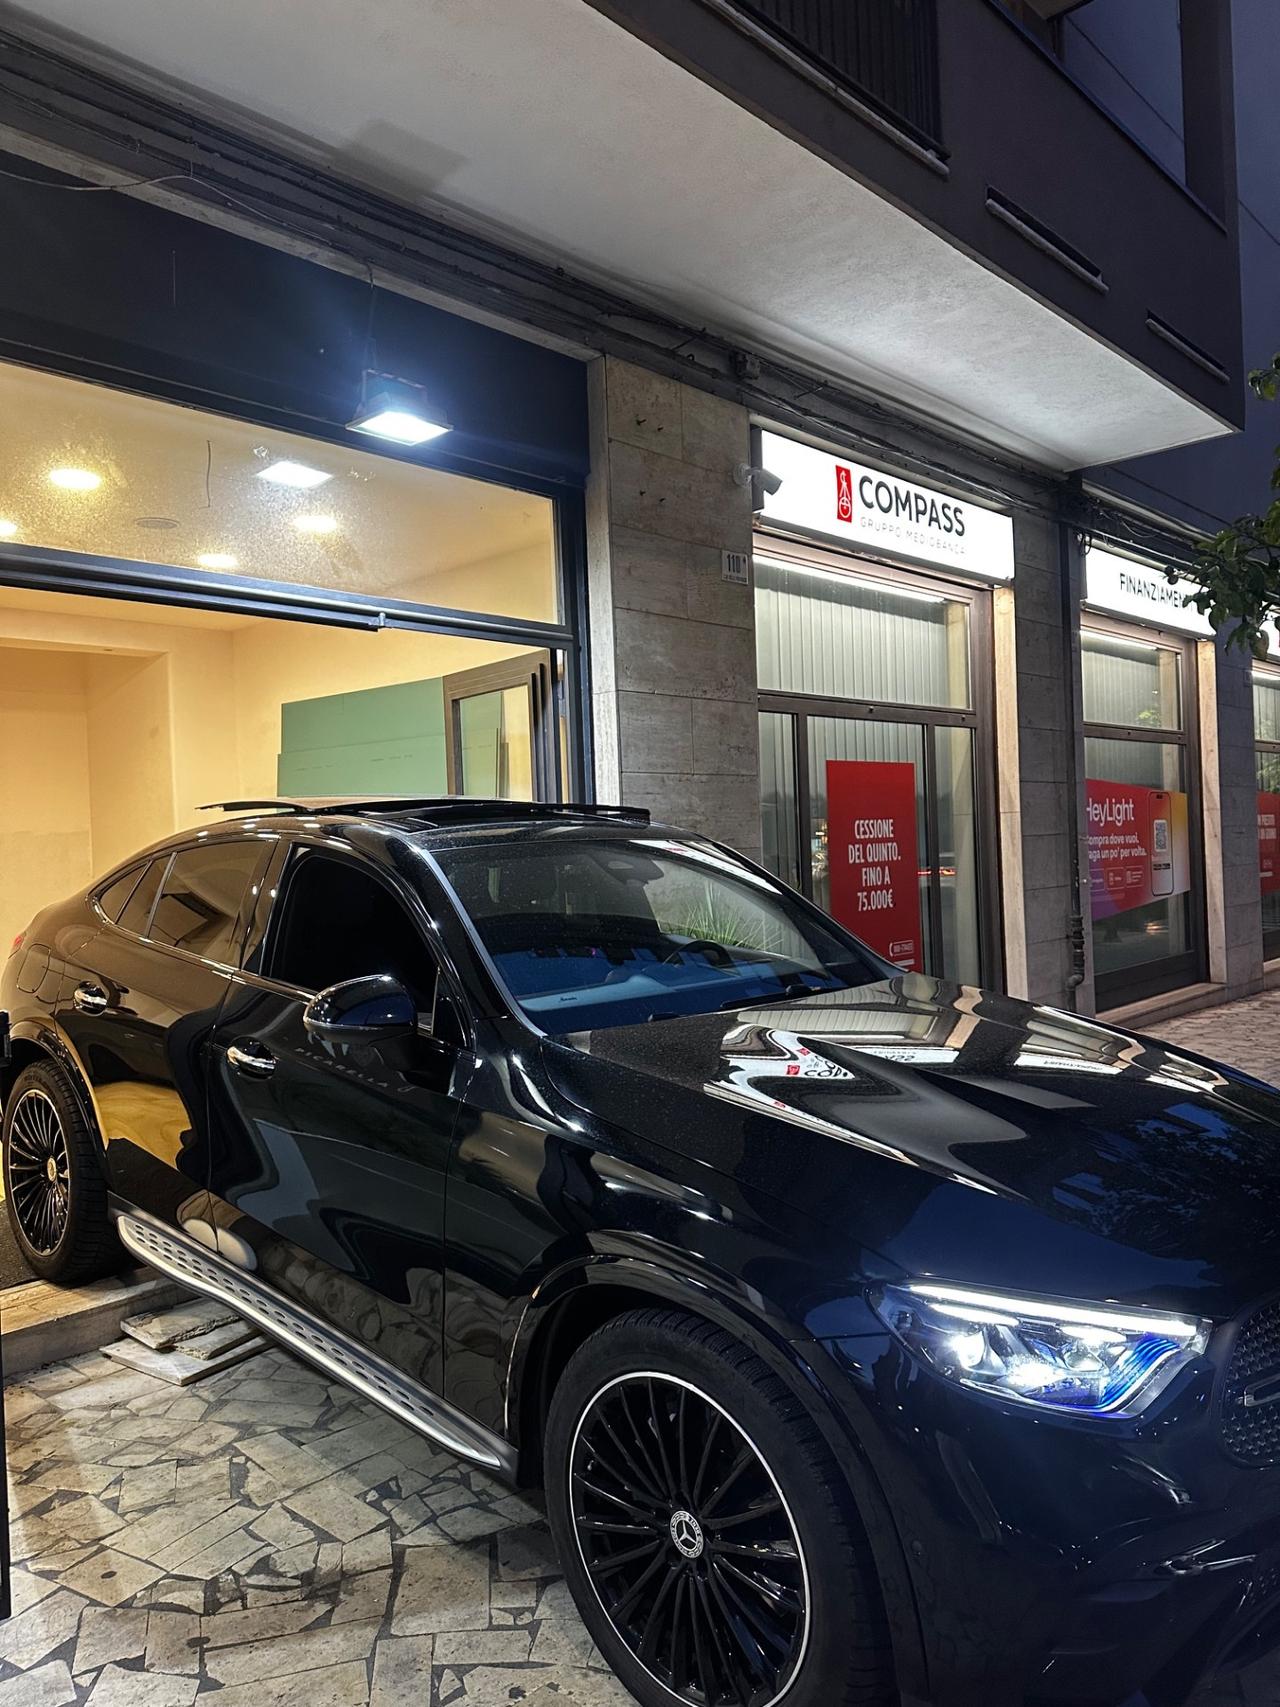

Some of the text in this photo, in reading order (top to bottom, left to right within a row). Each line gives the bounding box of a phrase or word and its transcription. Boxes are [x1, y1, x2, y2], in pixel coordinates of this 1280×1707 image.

[859, 475, 965, 537] COMPASS
[860, 516, 901, 538] GRUPPO
[1119, 572, 1193, 612] FINANZIAMEN
[854, 819, 894, 839] CESSIONE
[1088, 835, 1109, 848] ompra
[848, 842, 901, 864] DEL QUINTO.
[1088, 850, 1101, 862] aga
[862, 866, 891, 887] FINO A
[857, 889, 894, 912] 75.000€
